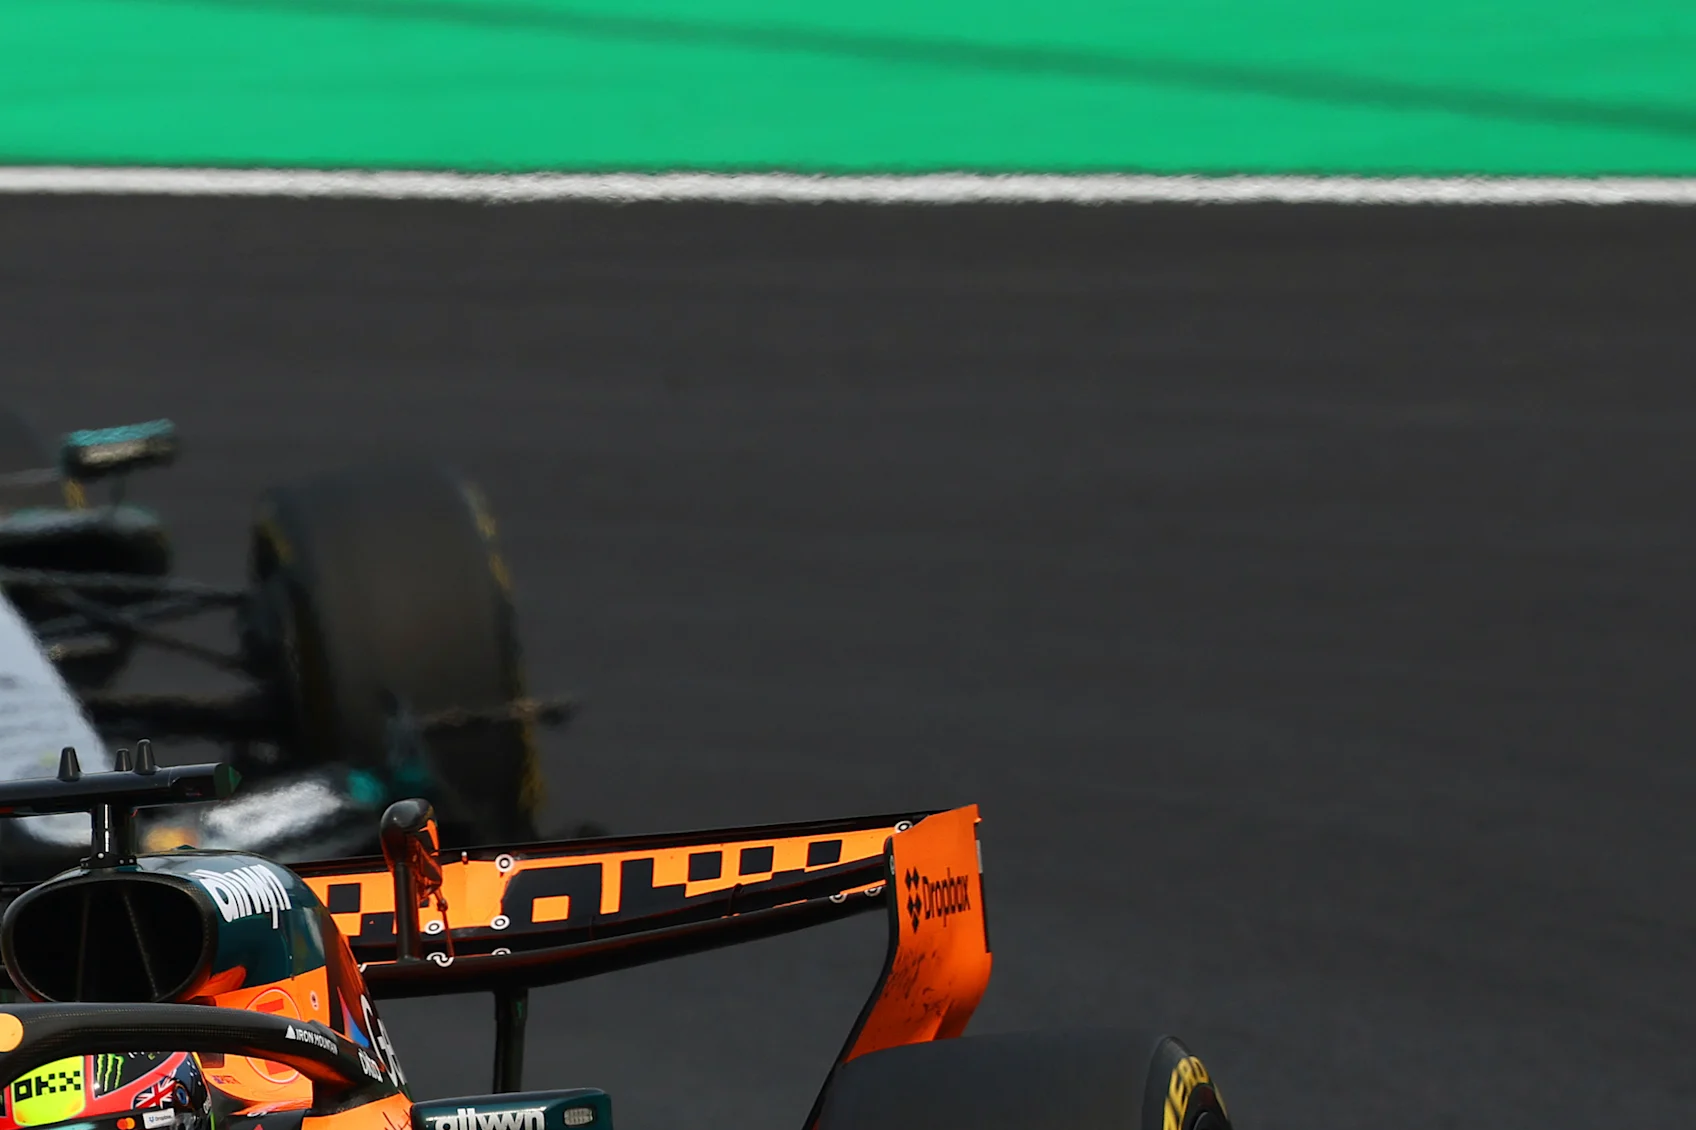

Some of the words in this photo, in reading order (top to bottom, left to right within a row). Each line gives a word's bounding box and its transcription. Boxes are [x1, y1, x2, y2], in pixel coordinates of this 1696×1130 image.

[187, 864, 292, 929] allwyn
[922, 867, 971, 928] Dropbox
[295, 1028, 313, 1044] IRON
[14, 1071, 81, 1102] OKX
